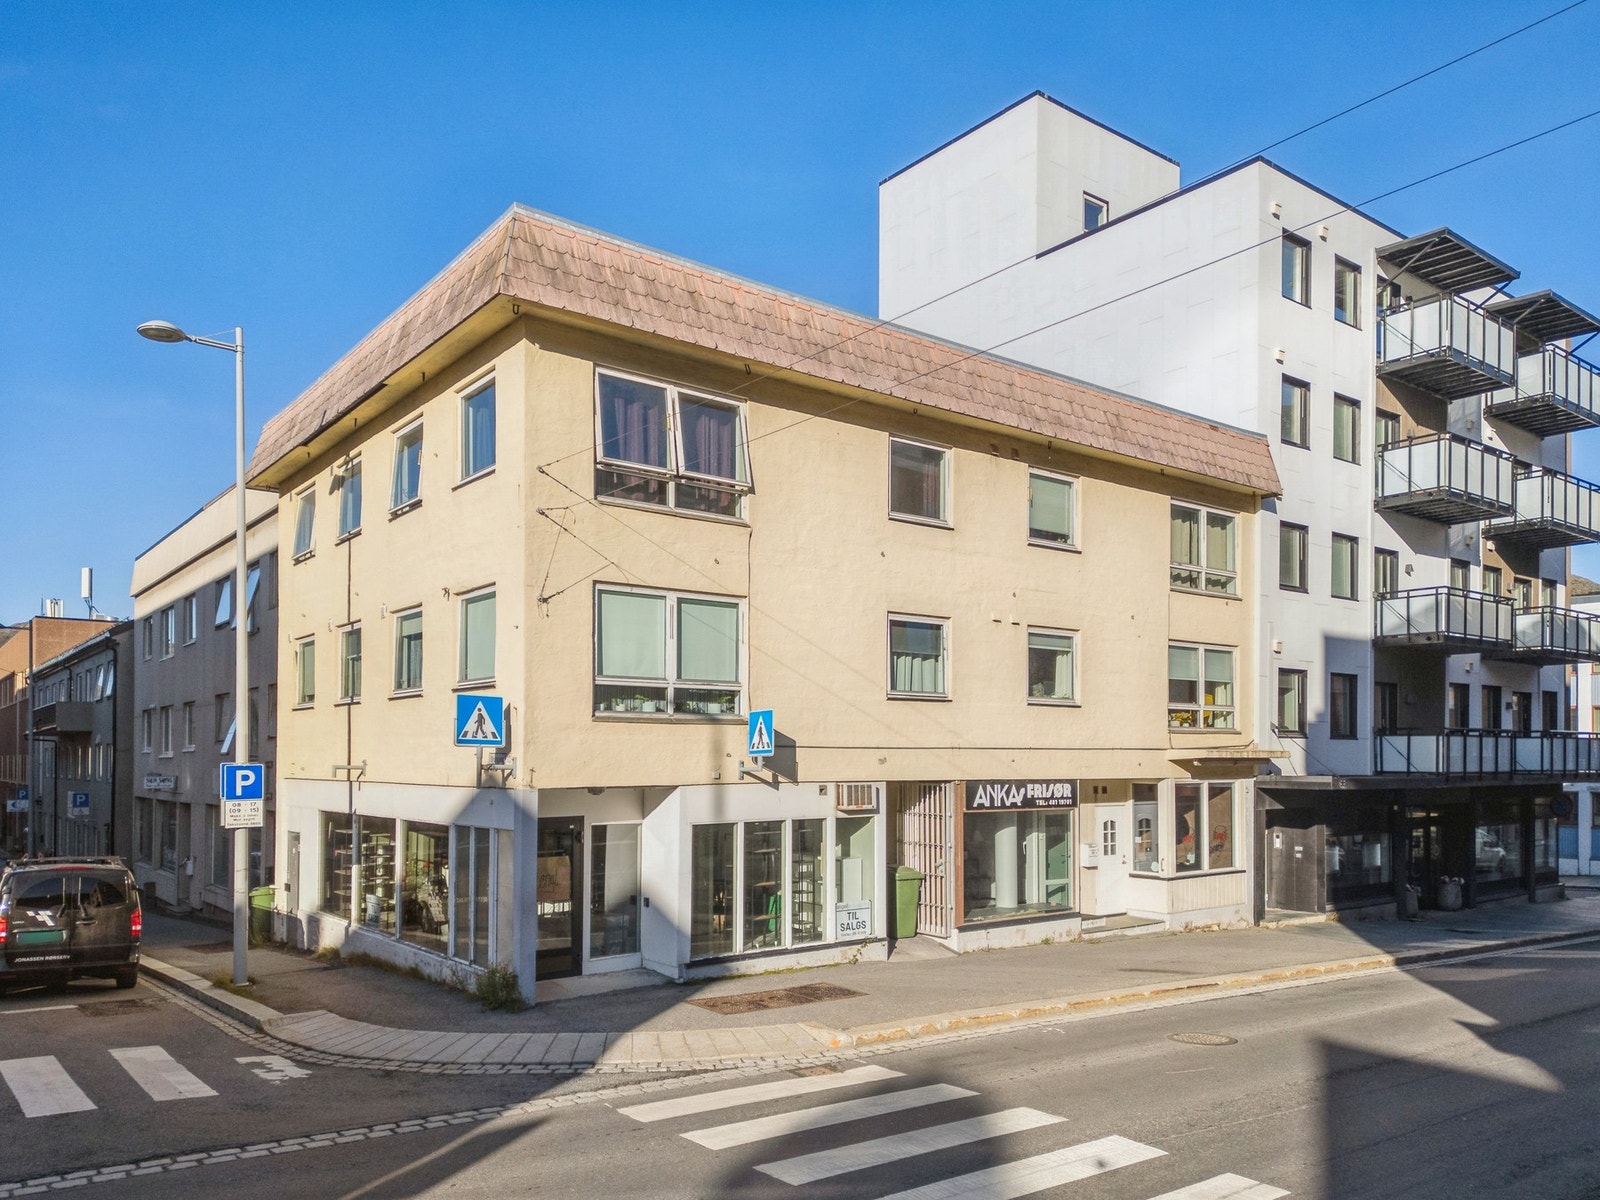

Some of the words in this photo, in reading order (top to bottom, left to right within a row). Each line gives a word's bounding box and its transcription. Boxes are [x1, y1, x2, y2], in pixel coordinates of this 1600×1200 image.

[236, 769, 256, 797] P
[19, 790, 26, 799] P
[1026, 782, 1073, 799] FRISØR
[76, 794, 86, 806] P
[847, 911, 859, 921] TIL
[840, 920, 867, 932] SALGS
[14, 955, 44, 963] JONASSEN
